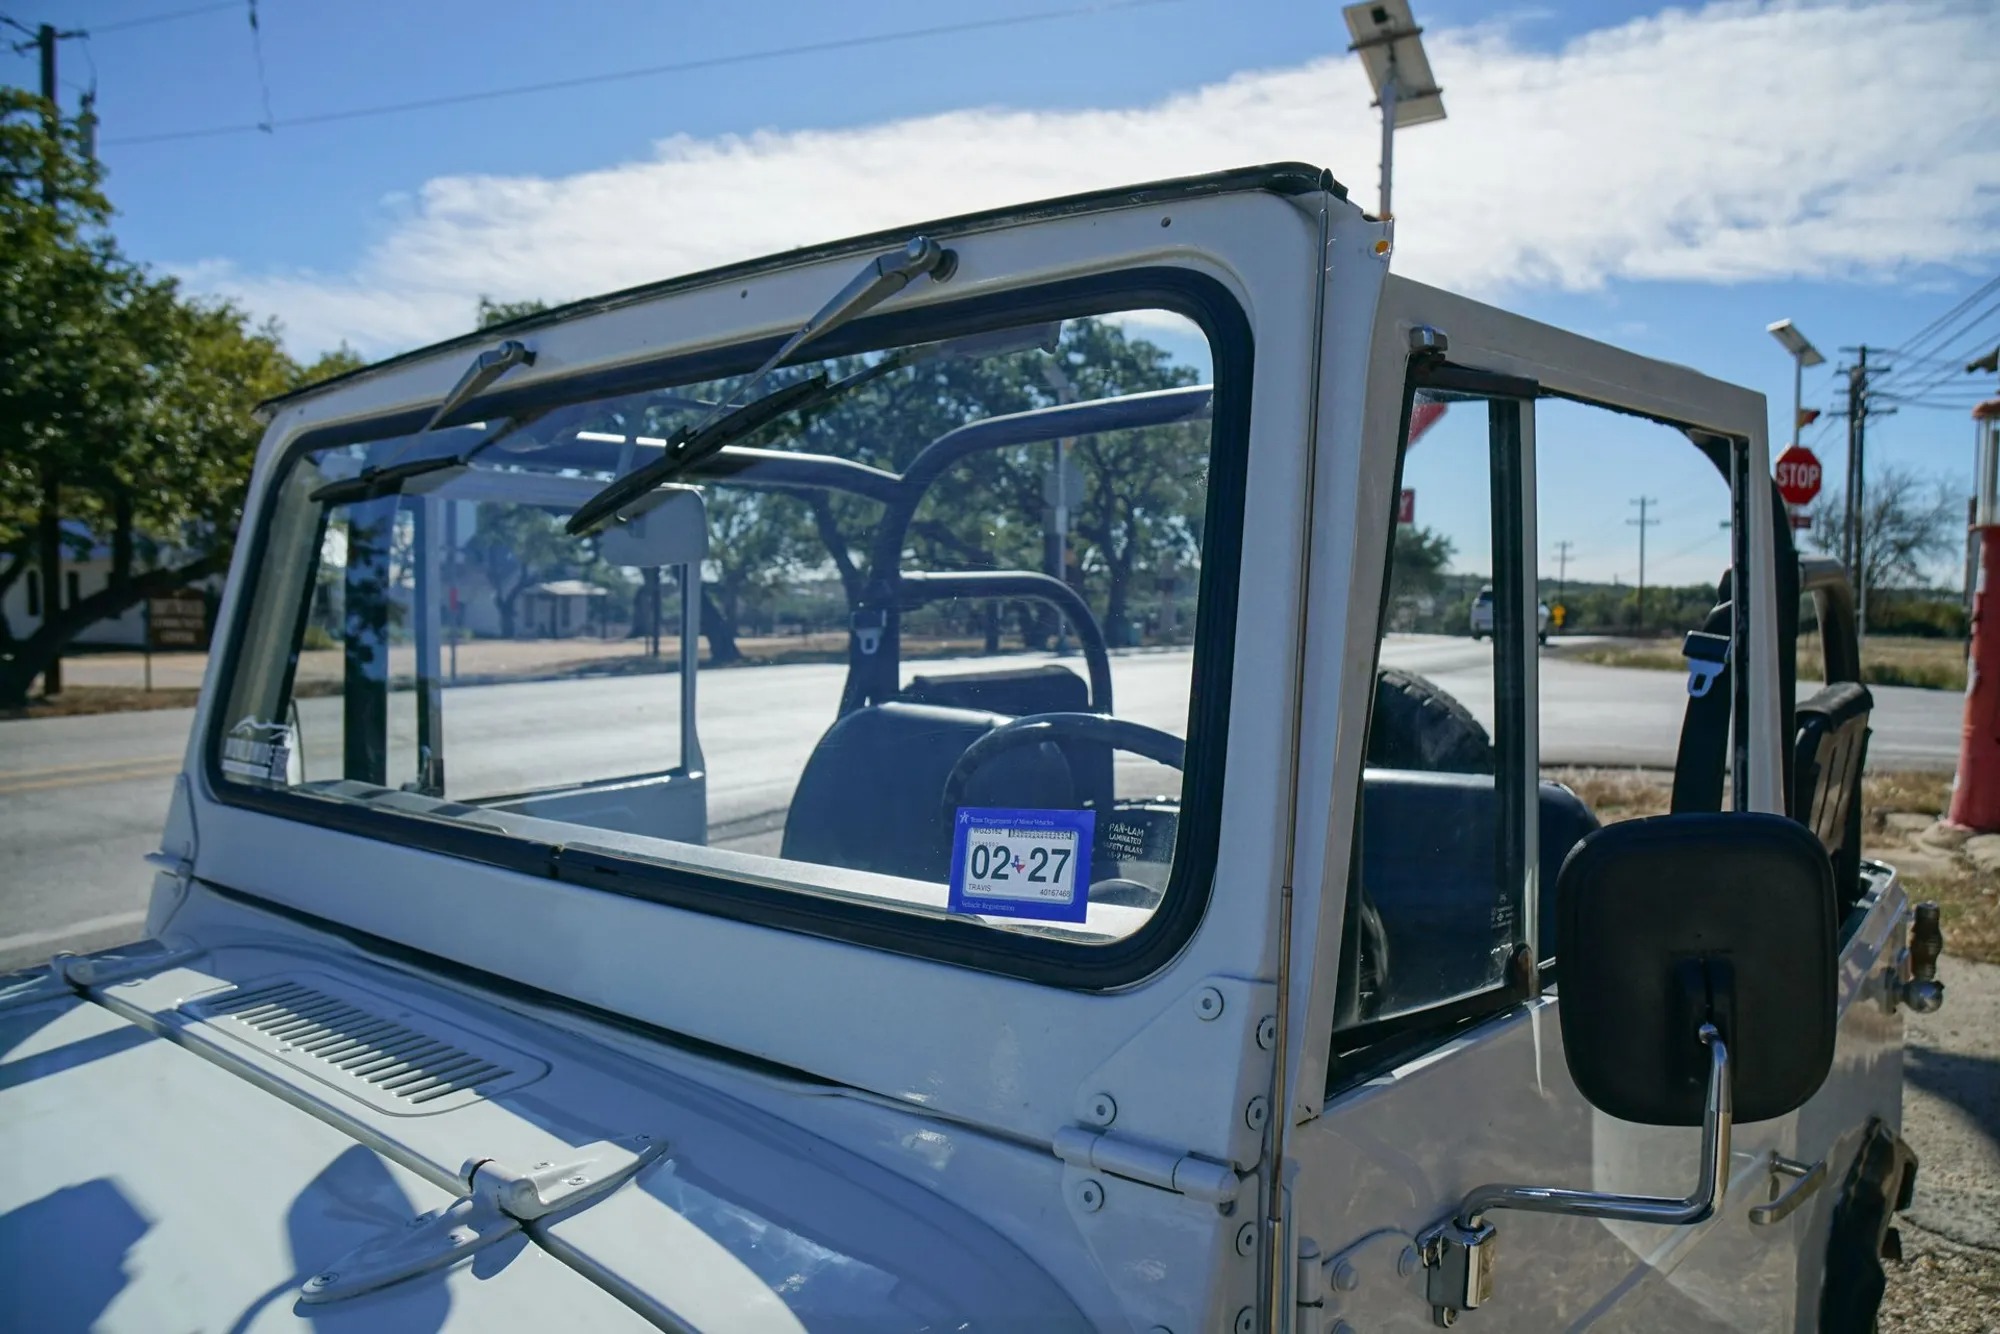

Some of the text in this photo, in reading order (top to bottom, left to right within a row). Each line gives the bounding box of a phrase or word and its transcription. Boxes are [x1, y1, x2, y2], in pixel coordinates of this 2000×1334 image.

[1777, 463, 1819, 489] STOP
[984, 817, 1012, 826] Department
[1109, 832, 1142, 845] LAMINATED
[1124, 845, 1143, 855] GLASS
[971, 844, 1071, 884] 02 27
[968, 883, 992, 893] TRAVIS
[961, 900, 1015, 912] Vehicle Registration
